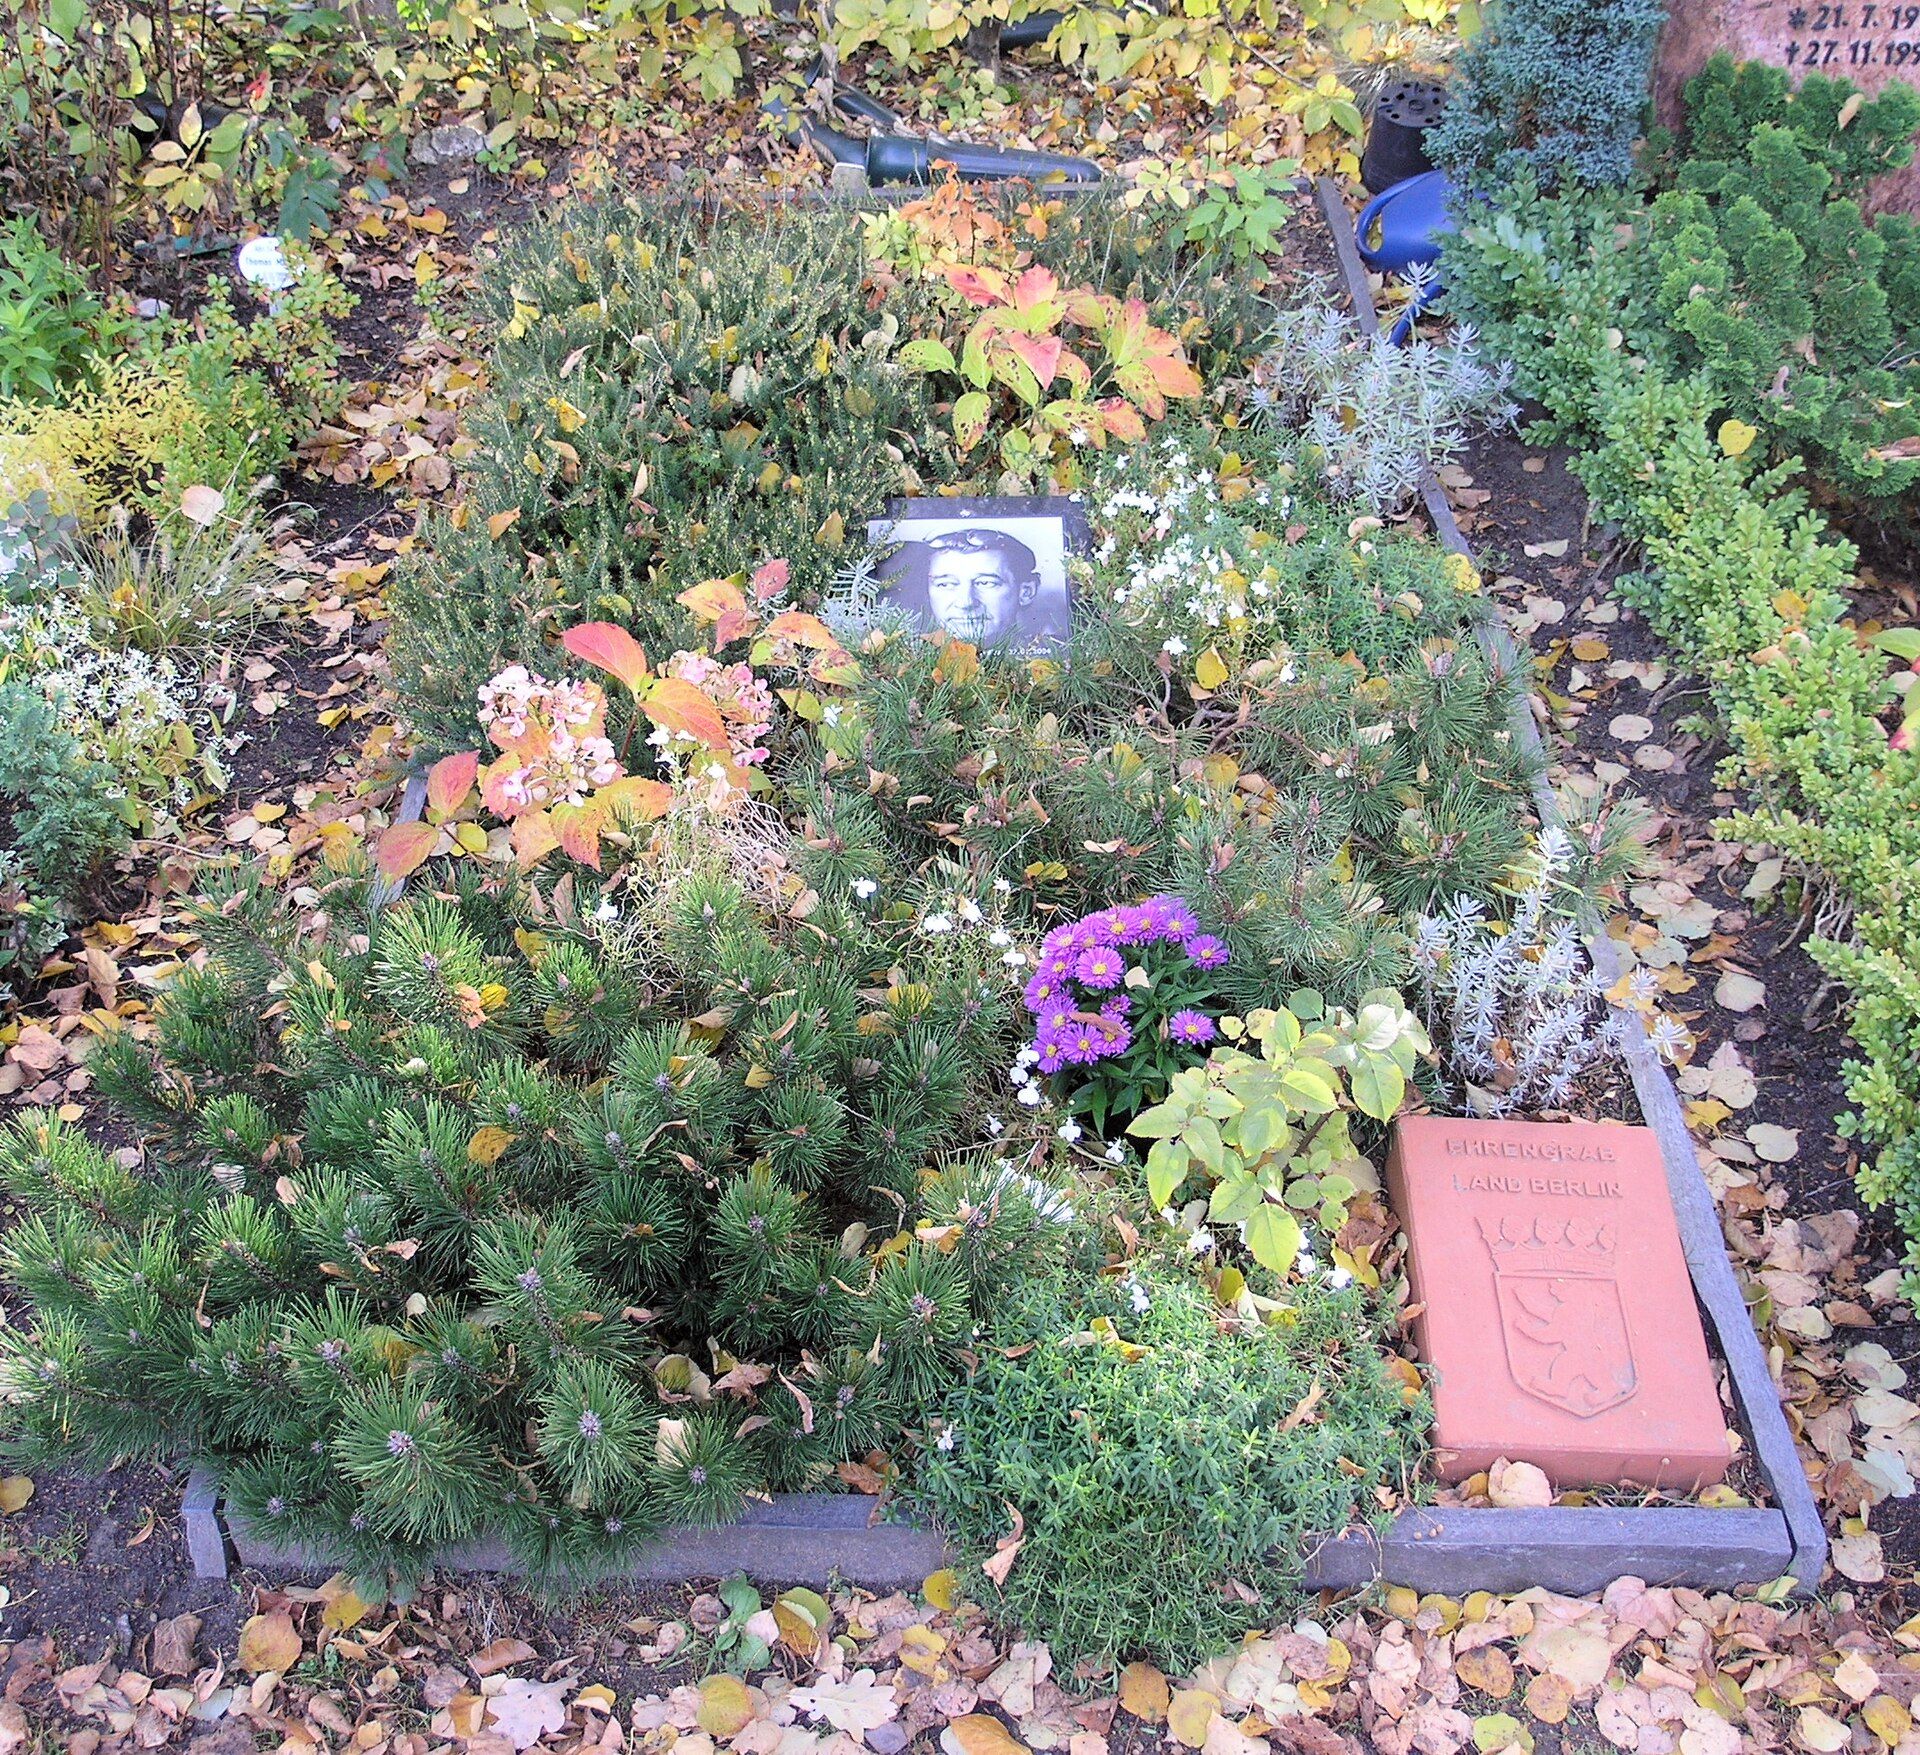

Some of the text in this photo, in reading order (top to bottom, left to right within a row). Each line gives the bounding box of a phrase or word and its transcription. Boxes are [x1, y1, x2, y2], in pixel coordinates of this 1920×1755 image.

[1811, 5, 1848, 31] 21.
[1803, 40, 1839, 66] 27.
[1446, 1138, 1617, 1162] EHRENGRAB
[1453, 1174, 1624, 1199] LAND BERLIN
